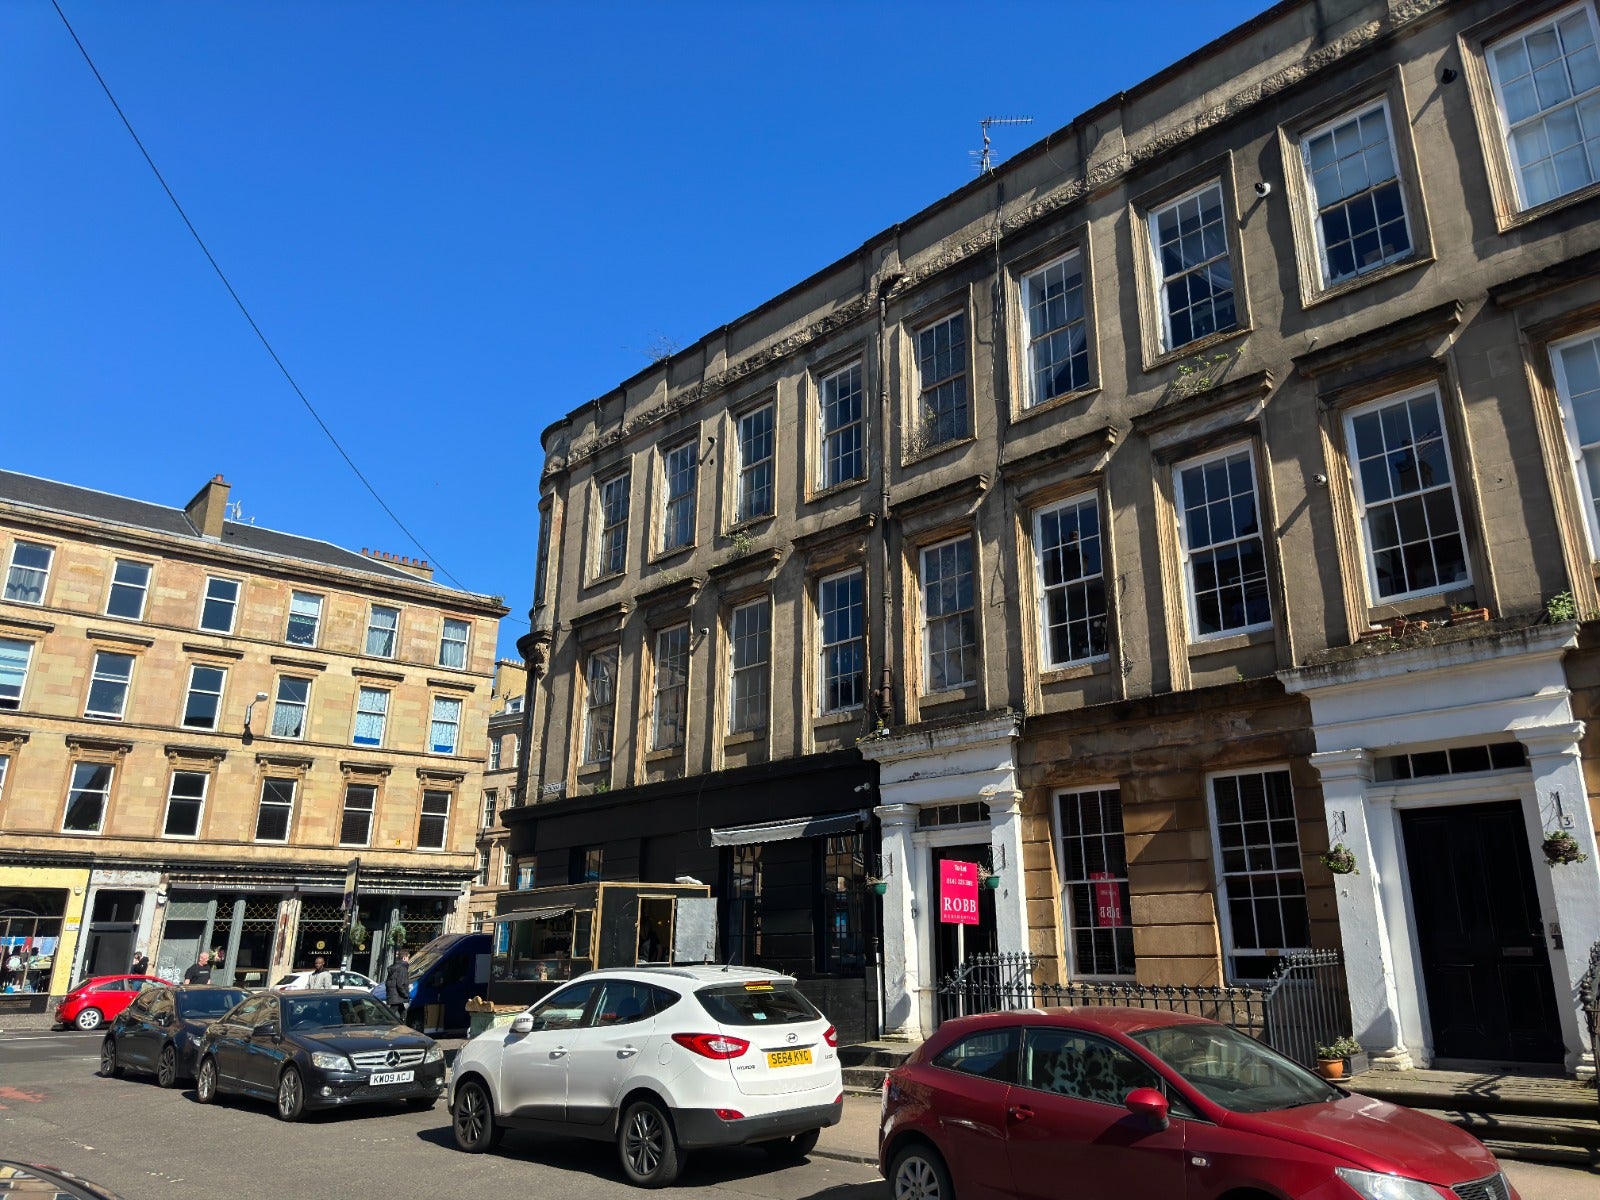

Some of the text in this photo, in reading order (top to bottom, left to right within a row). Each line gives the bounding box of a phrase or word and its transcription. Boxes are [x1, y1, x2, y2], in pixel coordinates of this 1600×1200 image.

[1563, 816, 1571, 826] 3
[943, 897, 976, 913] ROBB
[771, 1050, 809, 1065] SE64 KYC
[396, 1072, 411, 1082] ACJ
